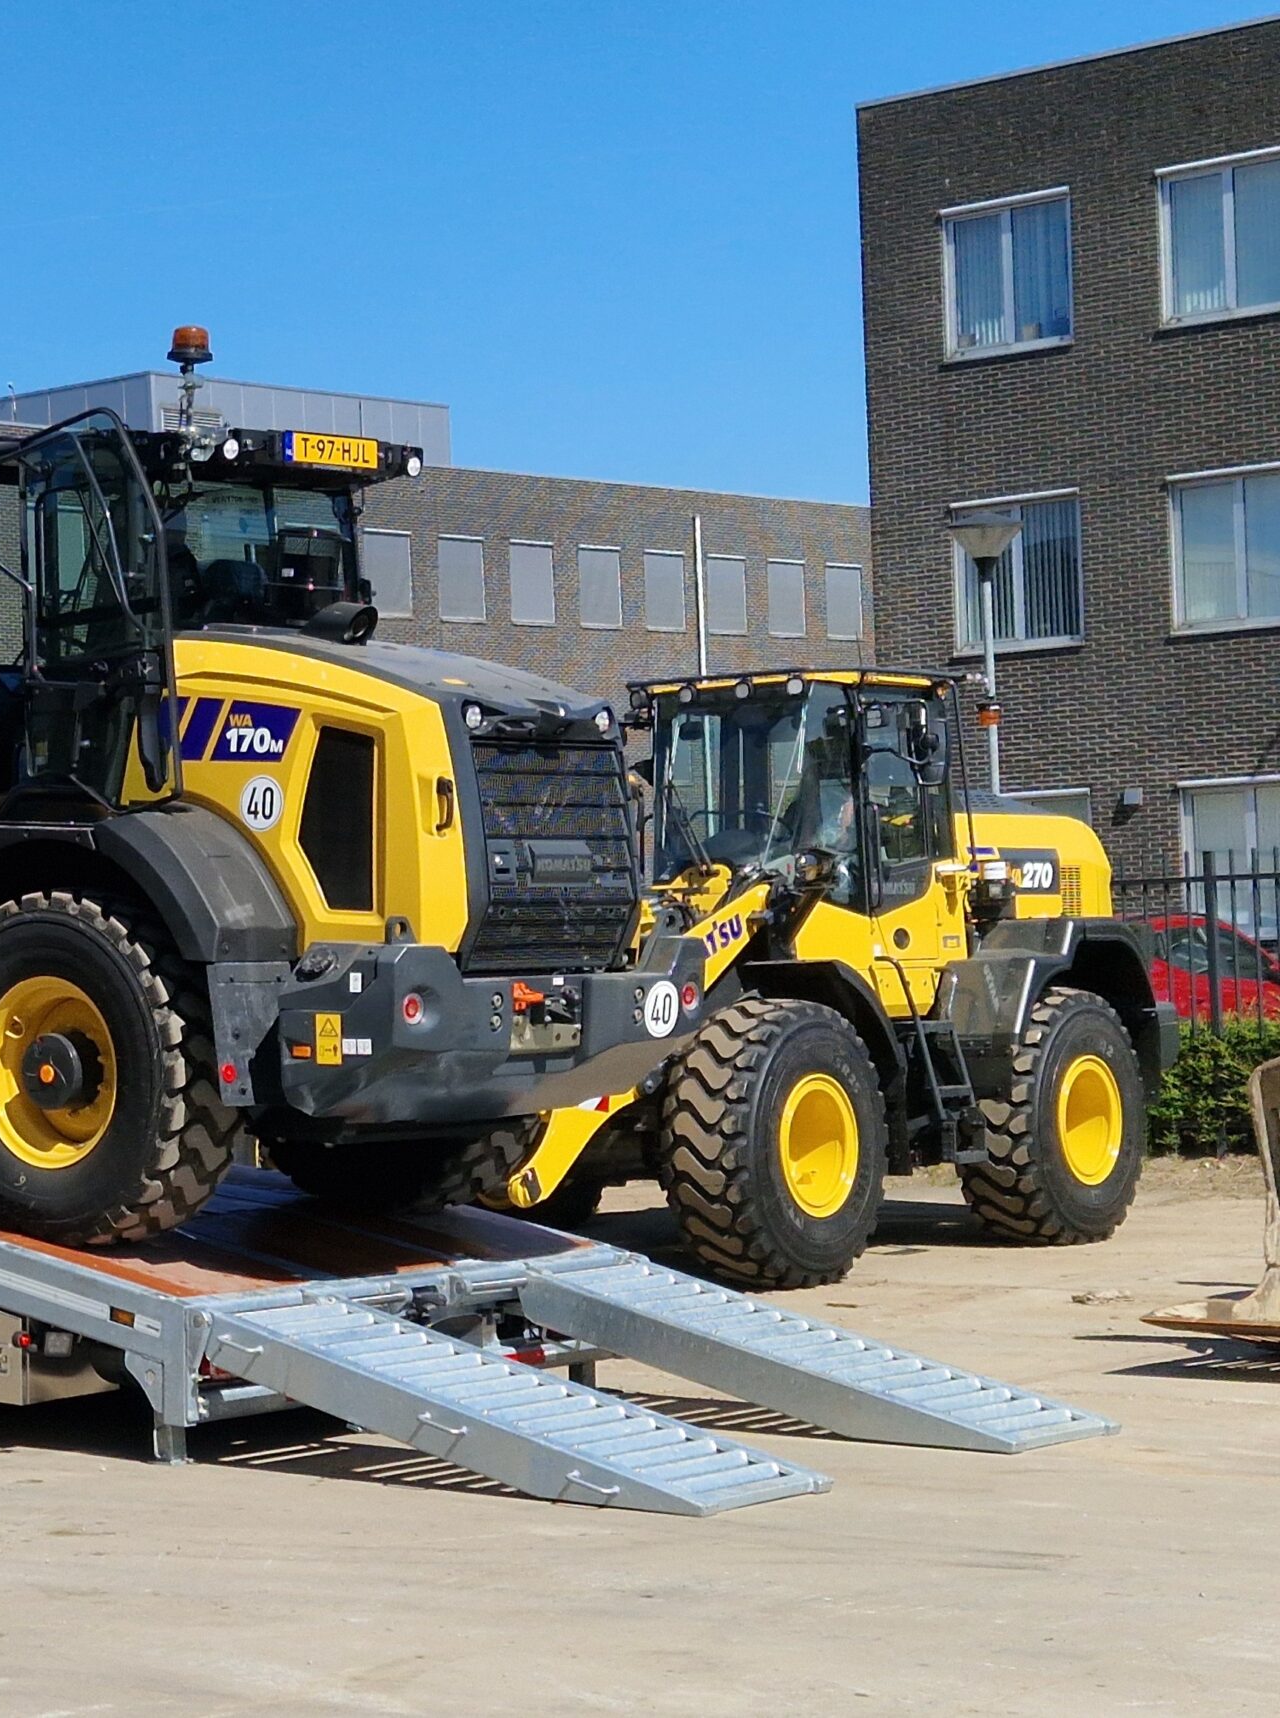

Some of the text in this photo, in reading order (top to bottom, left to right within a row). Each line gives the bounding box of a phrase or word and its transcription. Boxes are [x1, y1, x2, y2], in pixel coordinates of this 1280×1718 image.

[301, 437, 370, 464] T-97-HJL
[229, 714, 253, 727] WA
[226, 727, 283, 753] 170M
[247, 786, 274, 820] 40
[651, 993, 672, 1025] 40
